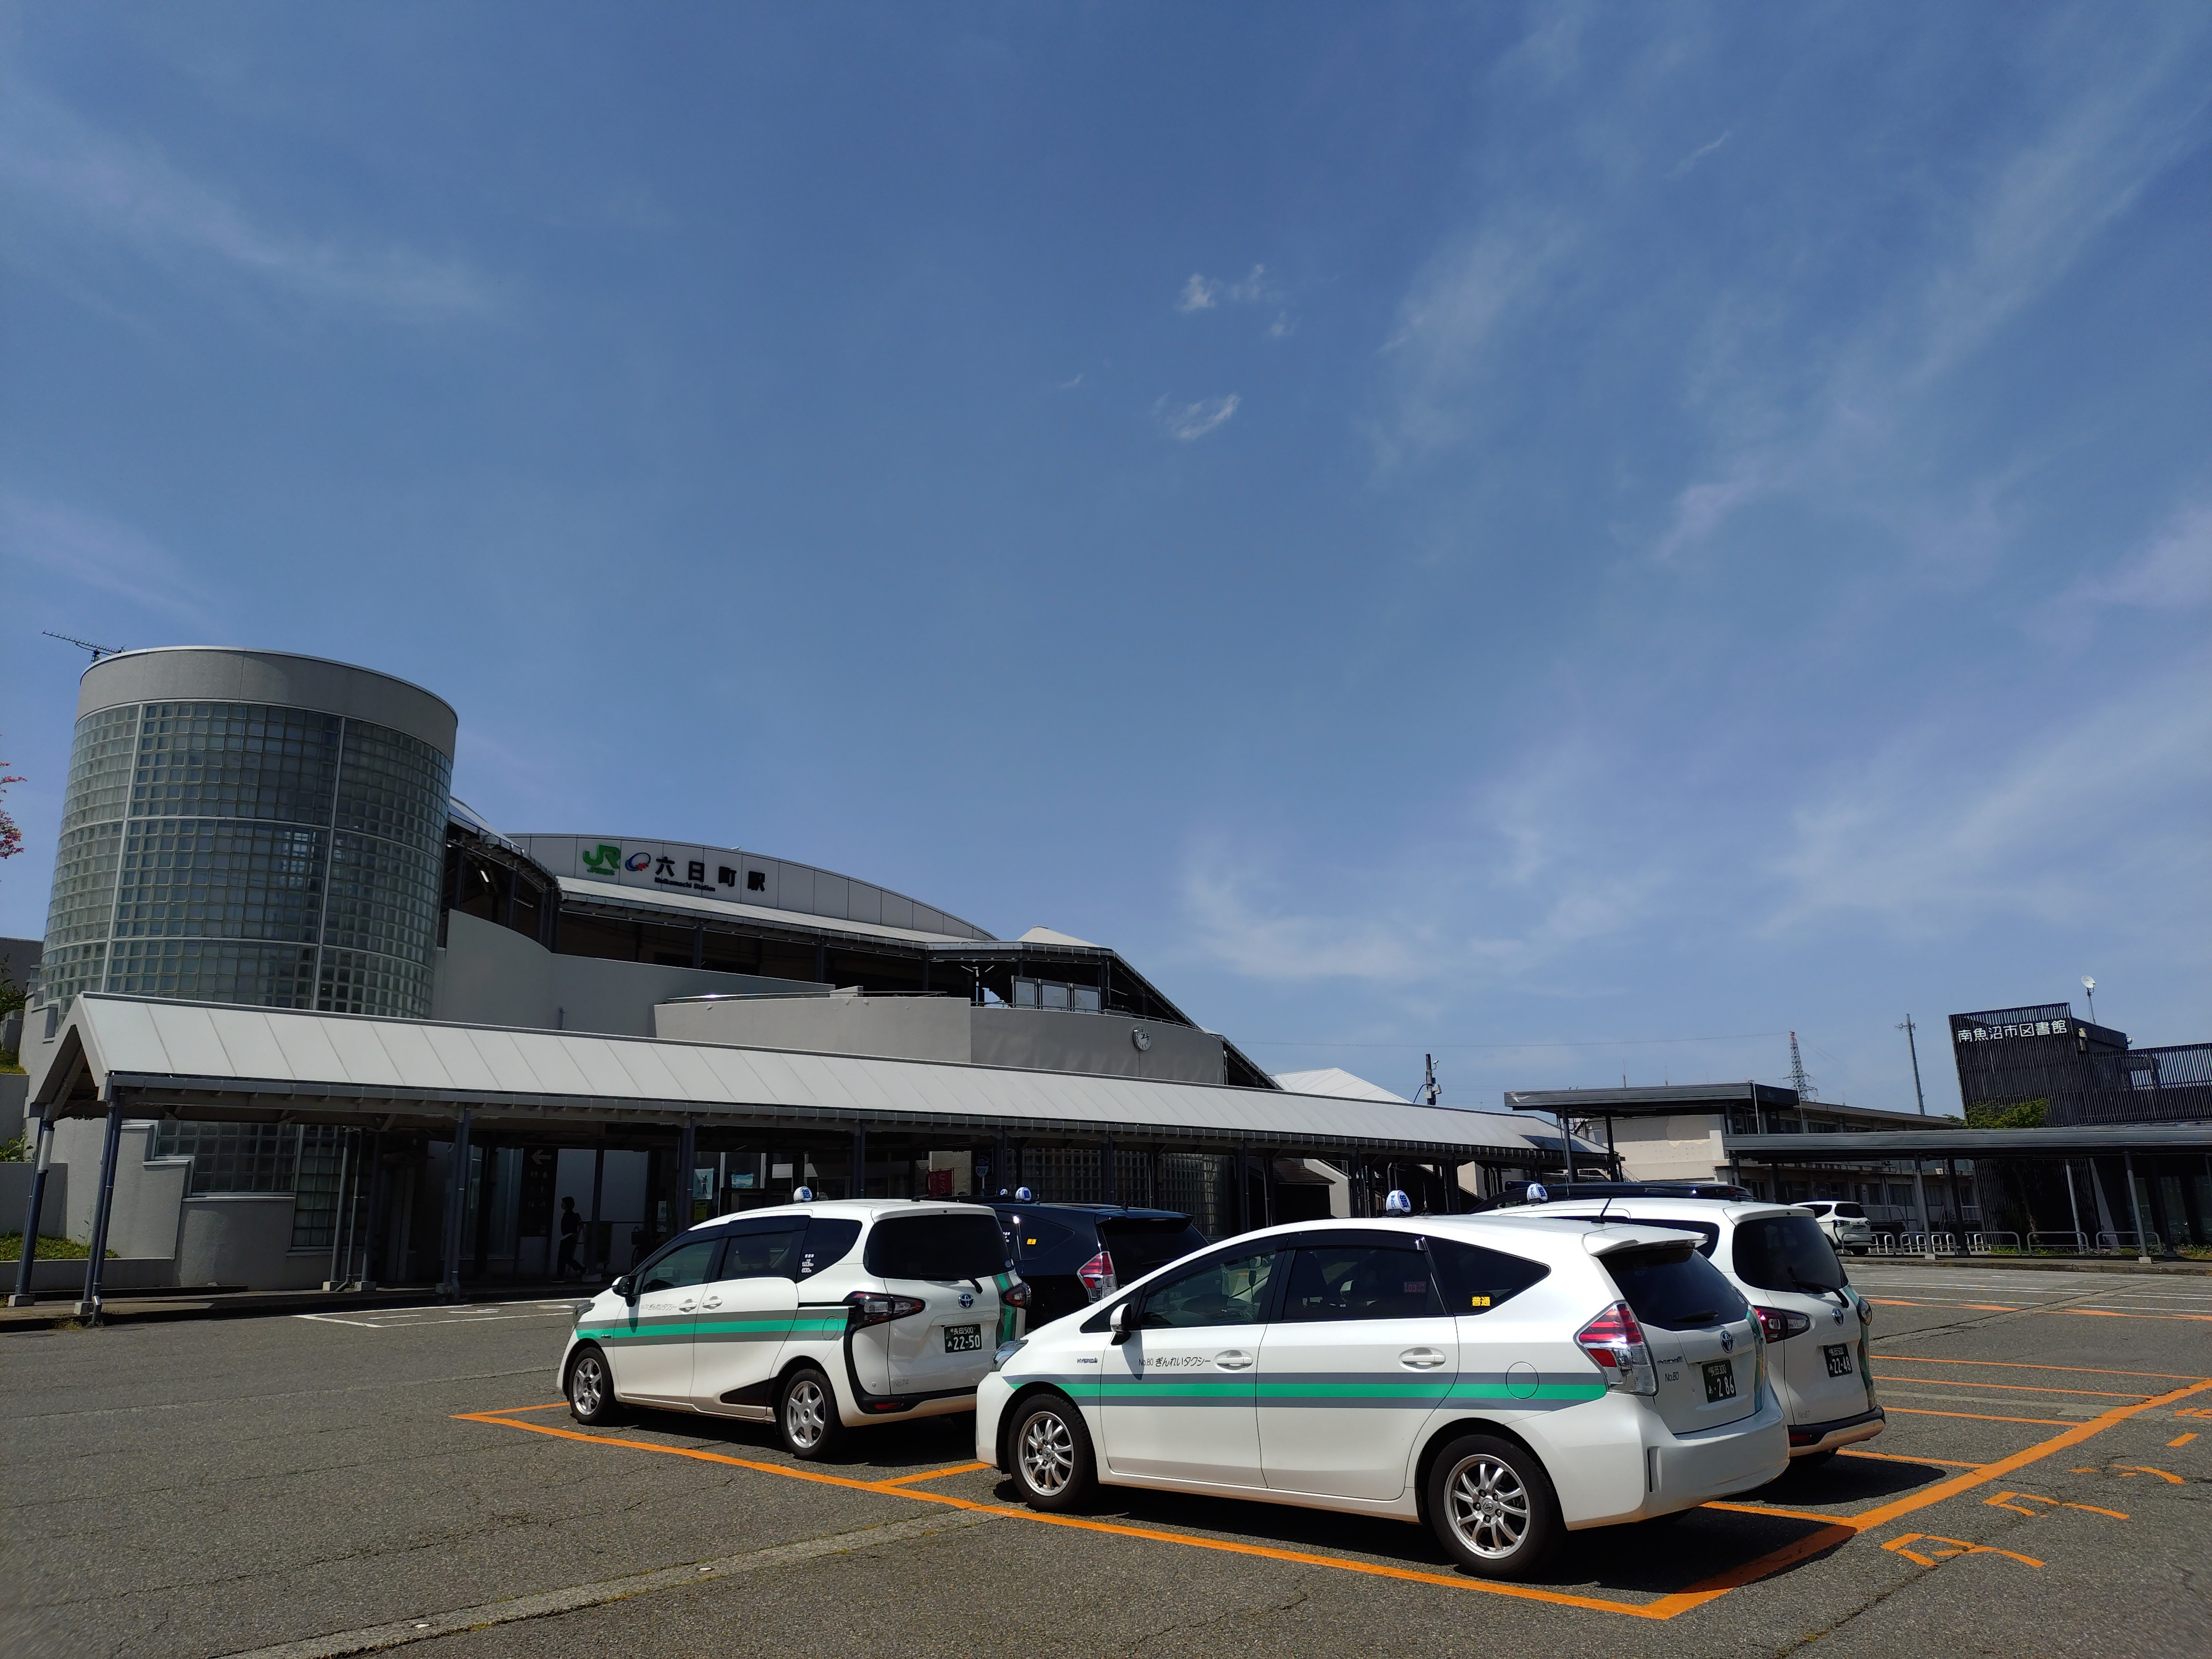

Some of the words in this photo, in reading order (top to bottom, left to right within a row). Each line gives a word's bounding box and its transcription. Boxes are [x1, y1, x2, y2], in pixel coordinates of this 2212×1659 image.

[583, 844, 620, 869] JR
[655, 856, 765, 892] 六日町駅
[693, 883, 716, 892] Station
[1957, 1020, 2068, 1044] 南魚沼市図書館
[1472, 1296, 1490, 1306] 普通
[953, 1334, 980, 1350] 22-50
[1155, 1357, 1211, 1367] ぎんれいタクシー
[1832, 1356, 1851, 1374] 22-48
